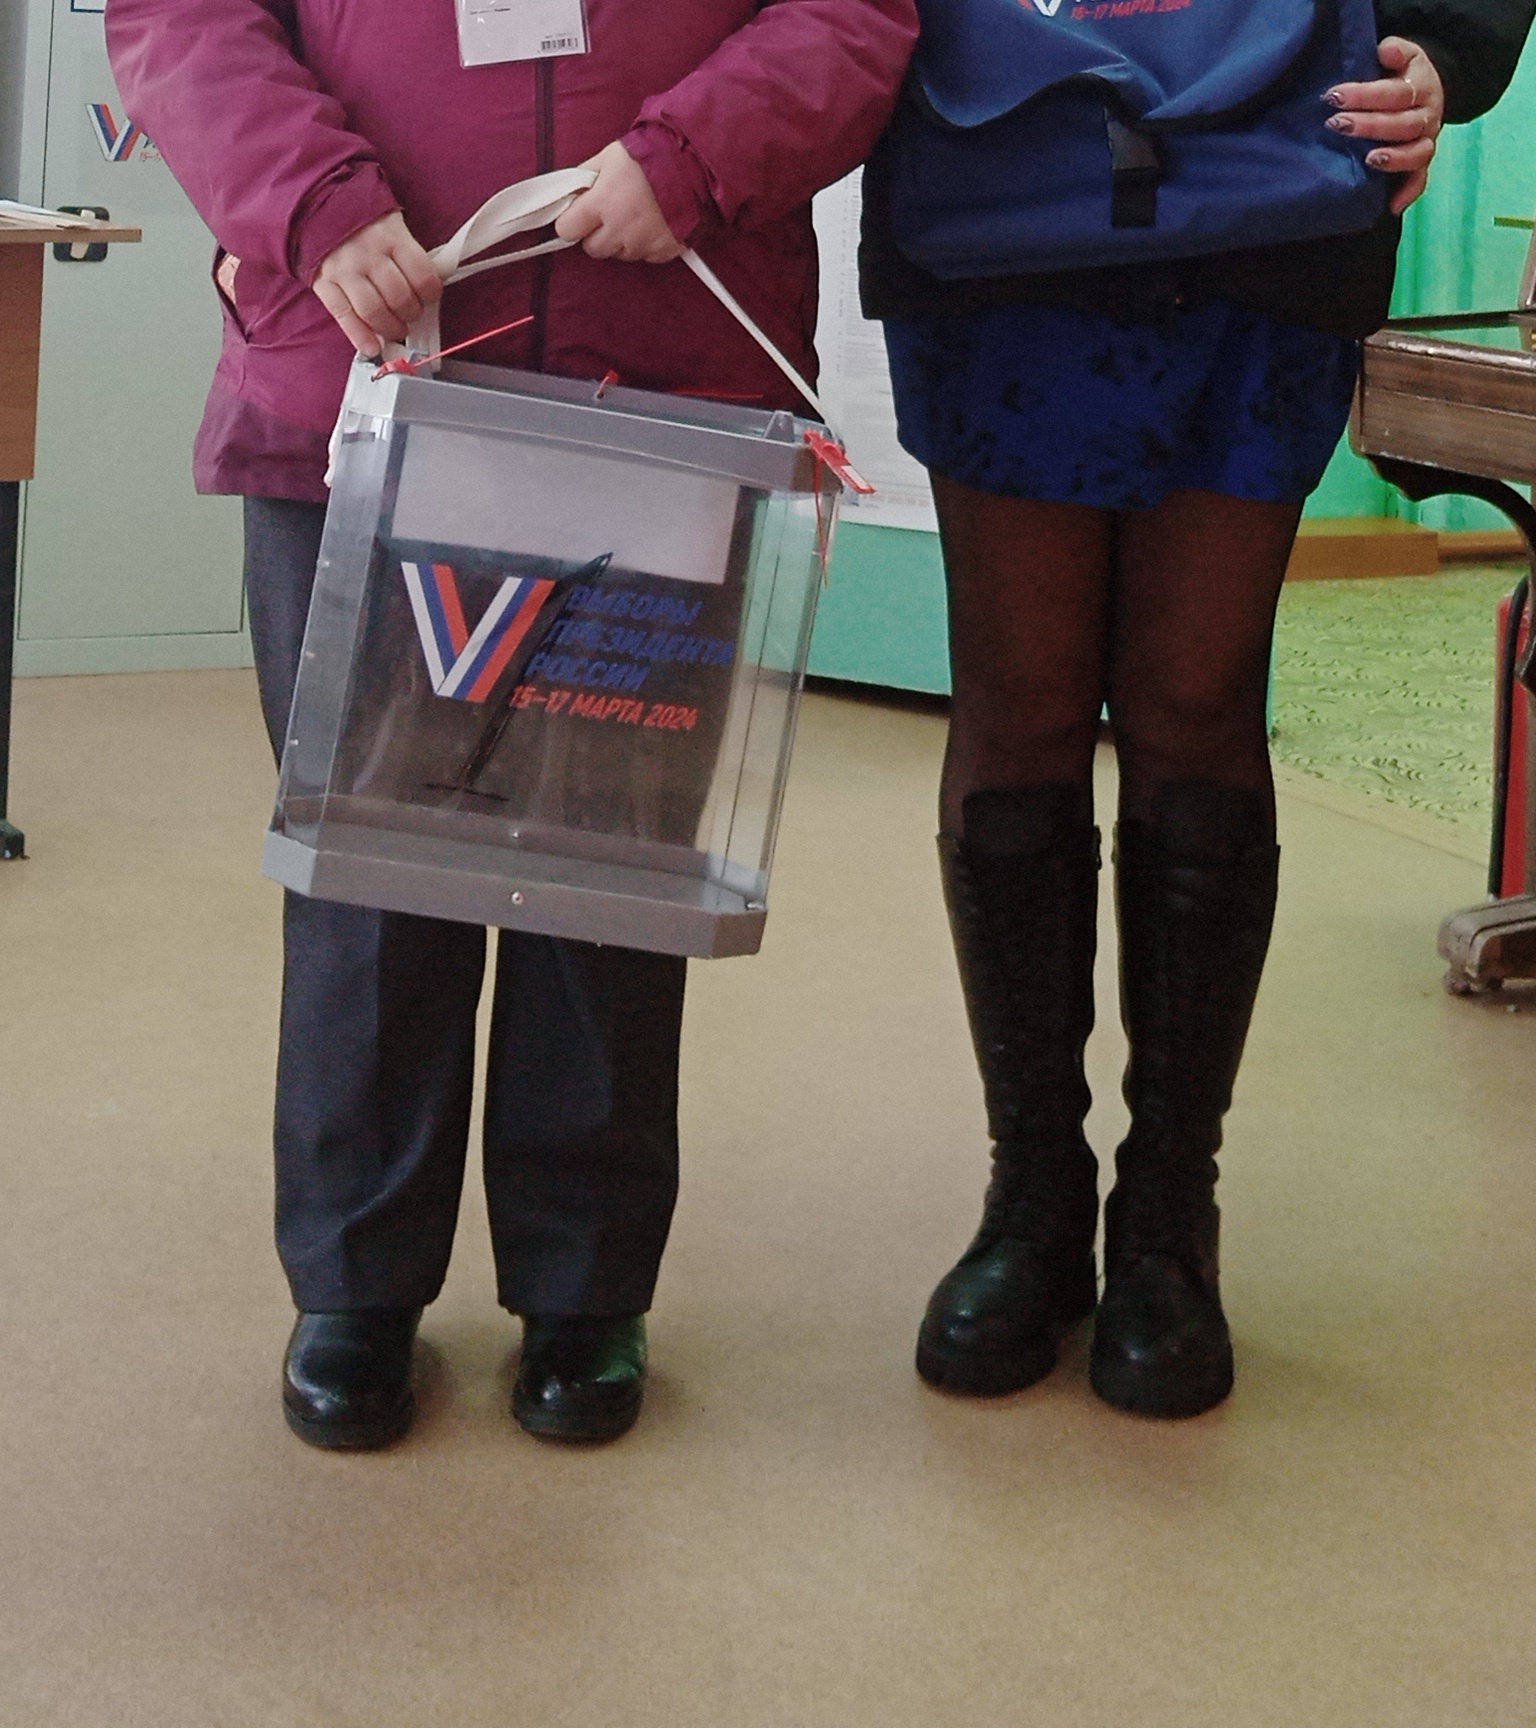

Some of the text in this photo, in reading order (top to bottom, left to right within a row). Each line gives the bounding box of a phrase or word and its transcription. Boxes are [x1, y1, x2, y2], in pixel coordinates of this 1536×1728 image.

[565, 585, 703, 626] ВЫБОРЫ
[543, 618, 734, 667] ПРЕЗИДЕНТА
[523, 650, 651, 692] РОССИИ
[568, 693, 645, 724] МАРТА
[644, 703, 699, 731] 2024
